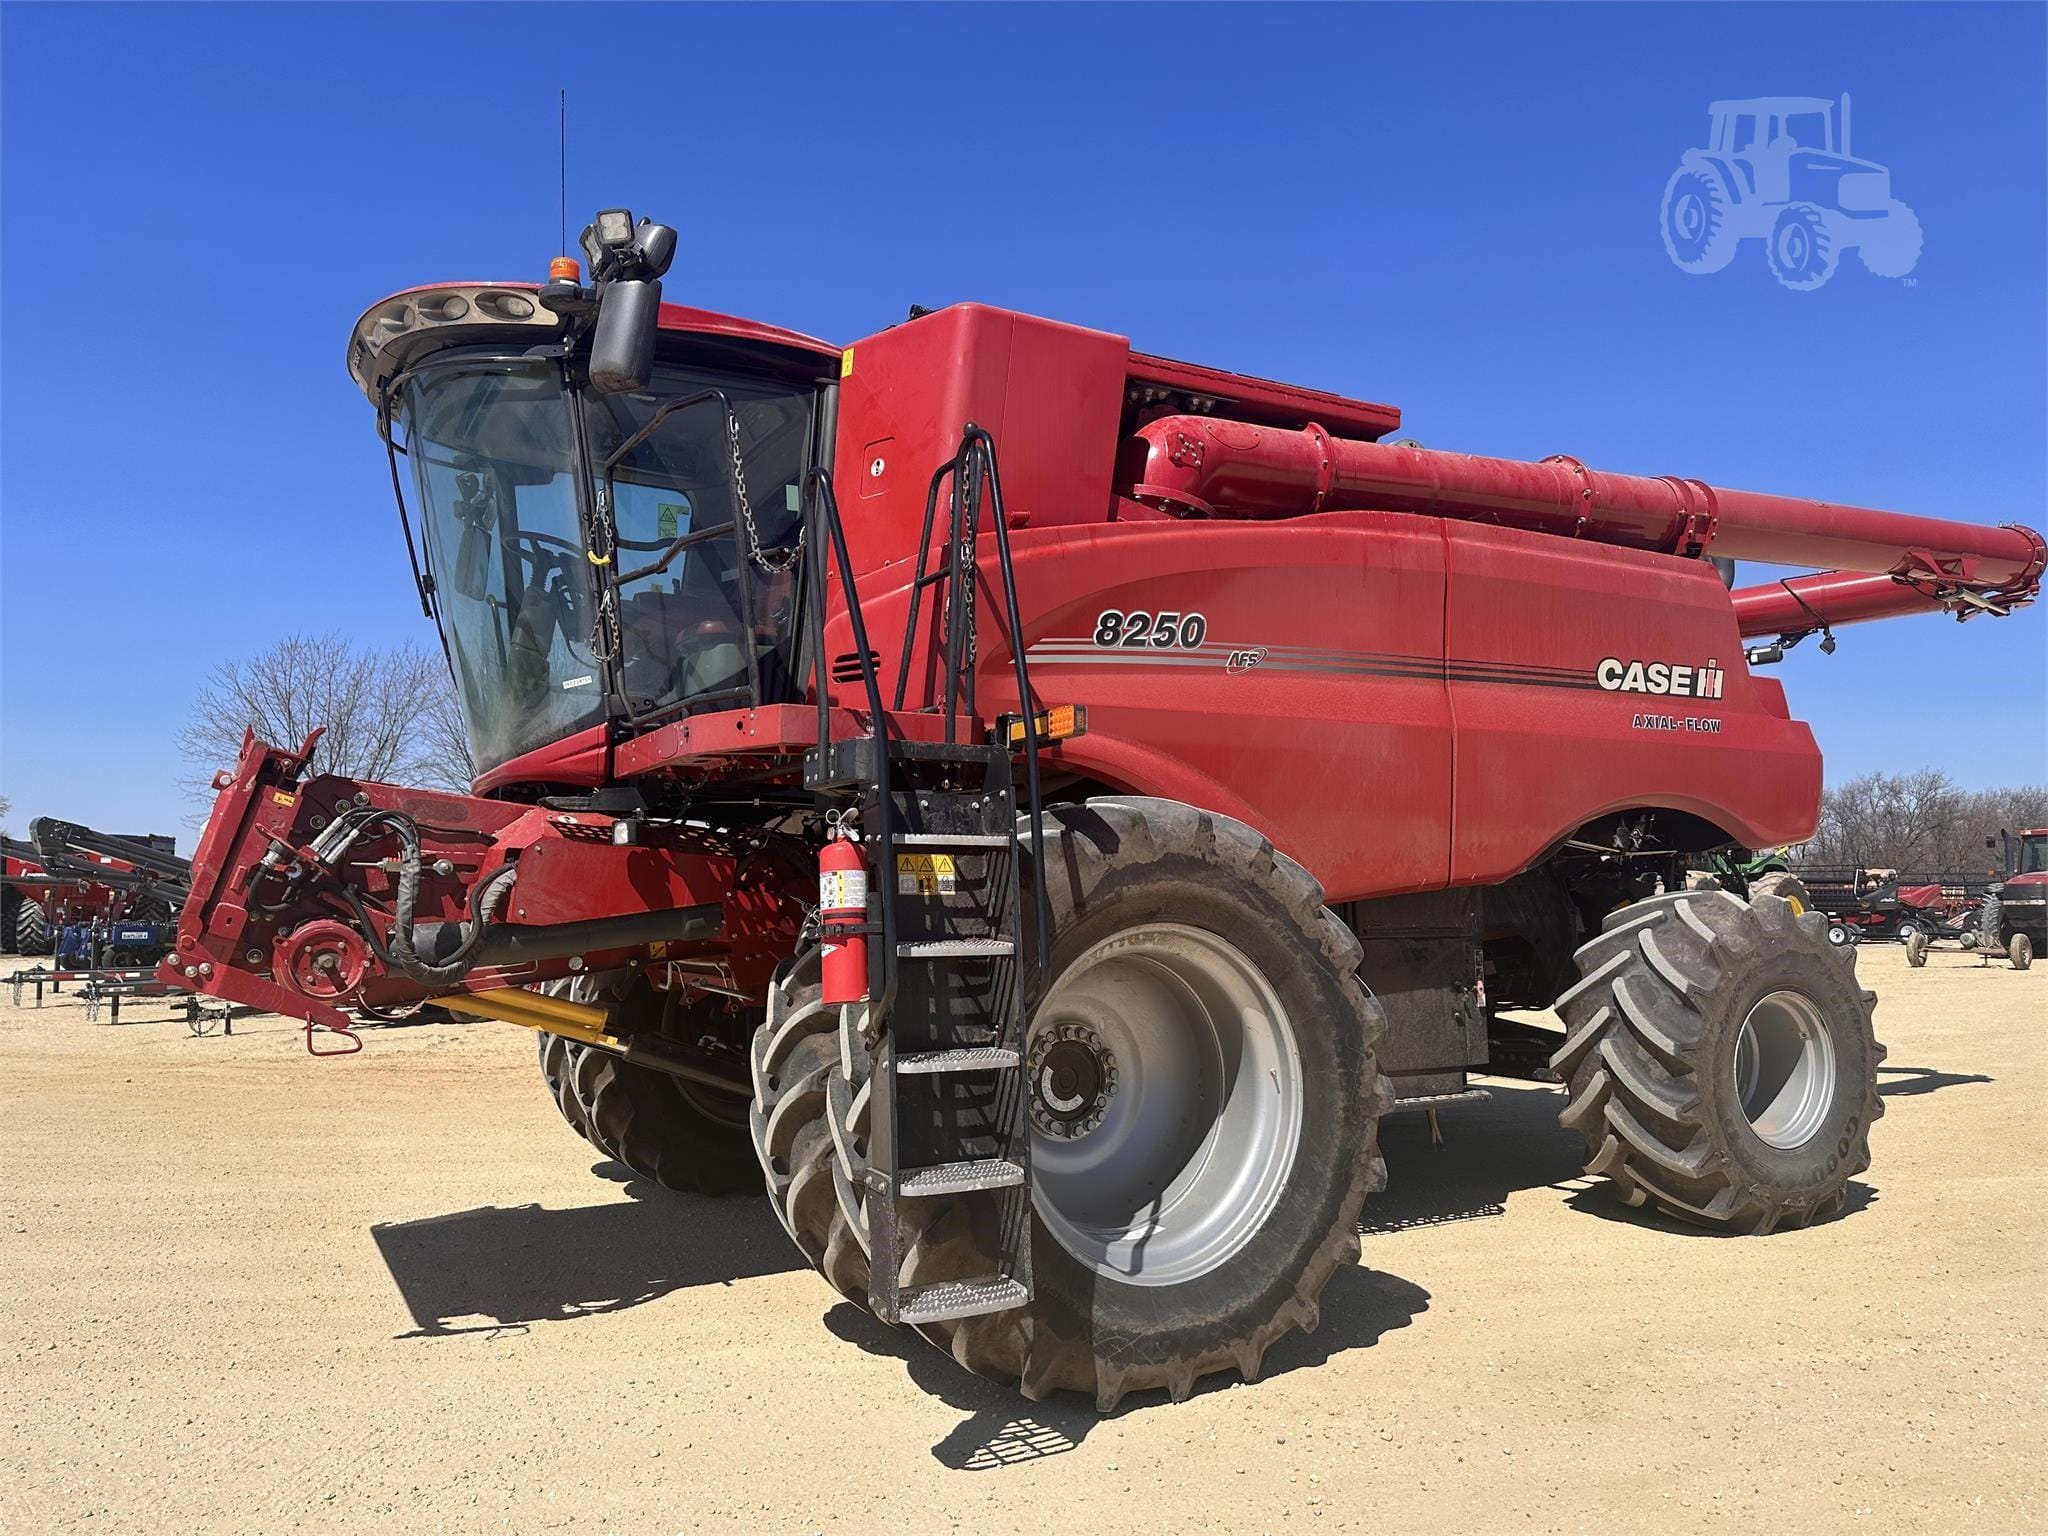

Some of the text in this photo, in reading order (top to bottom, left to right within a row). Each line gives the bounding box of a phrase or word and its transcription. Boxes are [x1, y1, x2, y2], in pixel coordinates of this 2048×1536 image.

[1094, 610, 1207, 650] 8250
[1226, 649, 1261, 669] AFS
[1597, 657, 1693, 696] CASE
[1632, 714, 1721, 733] AXIAL-FLOW
